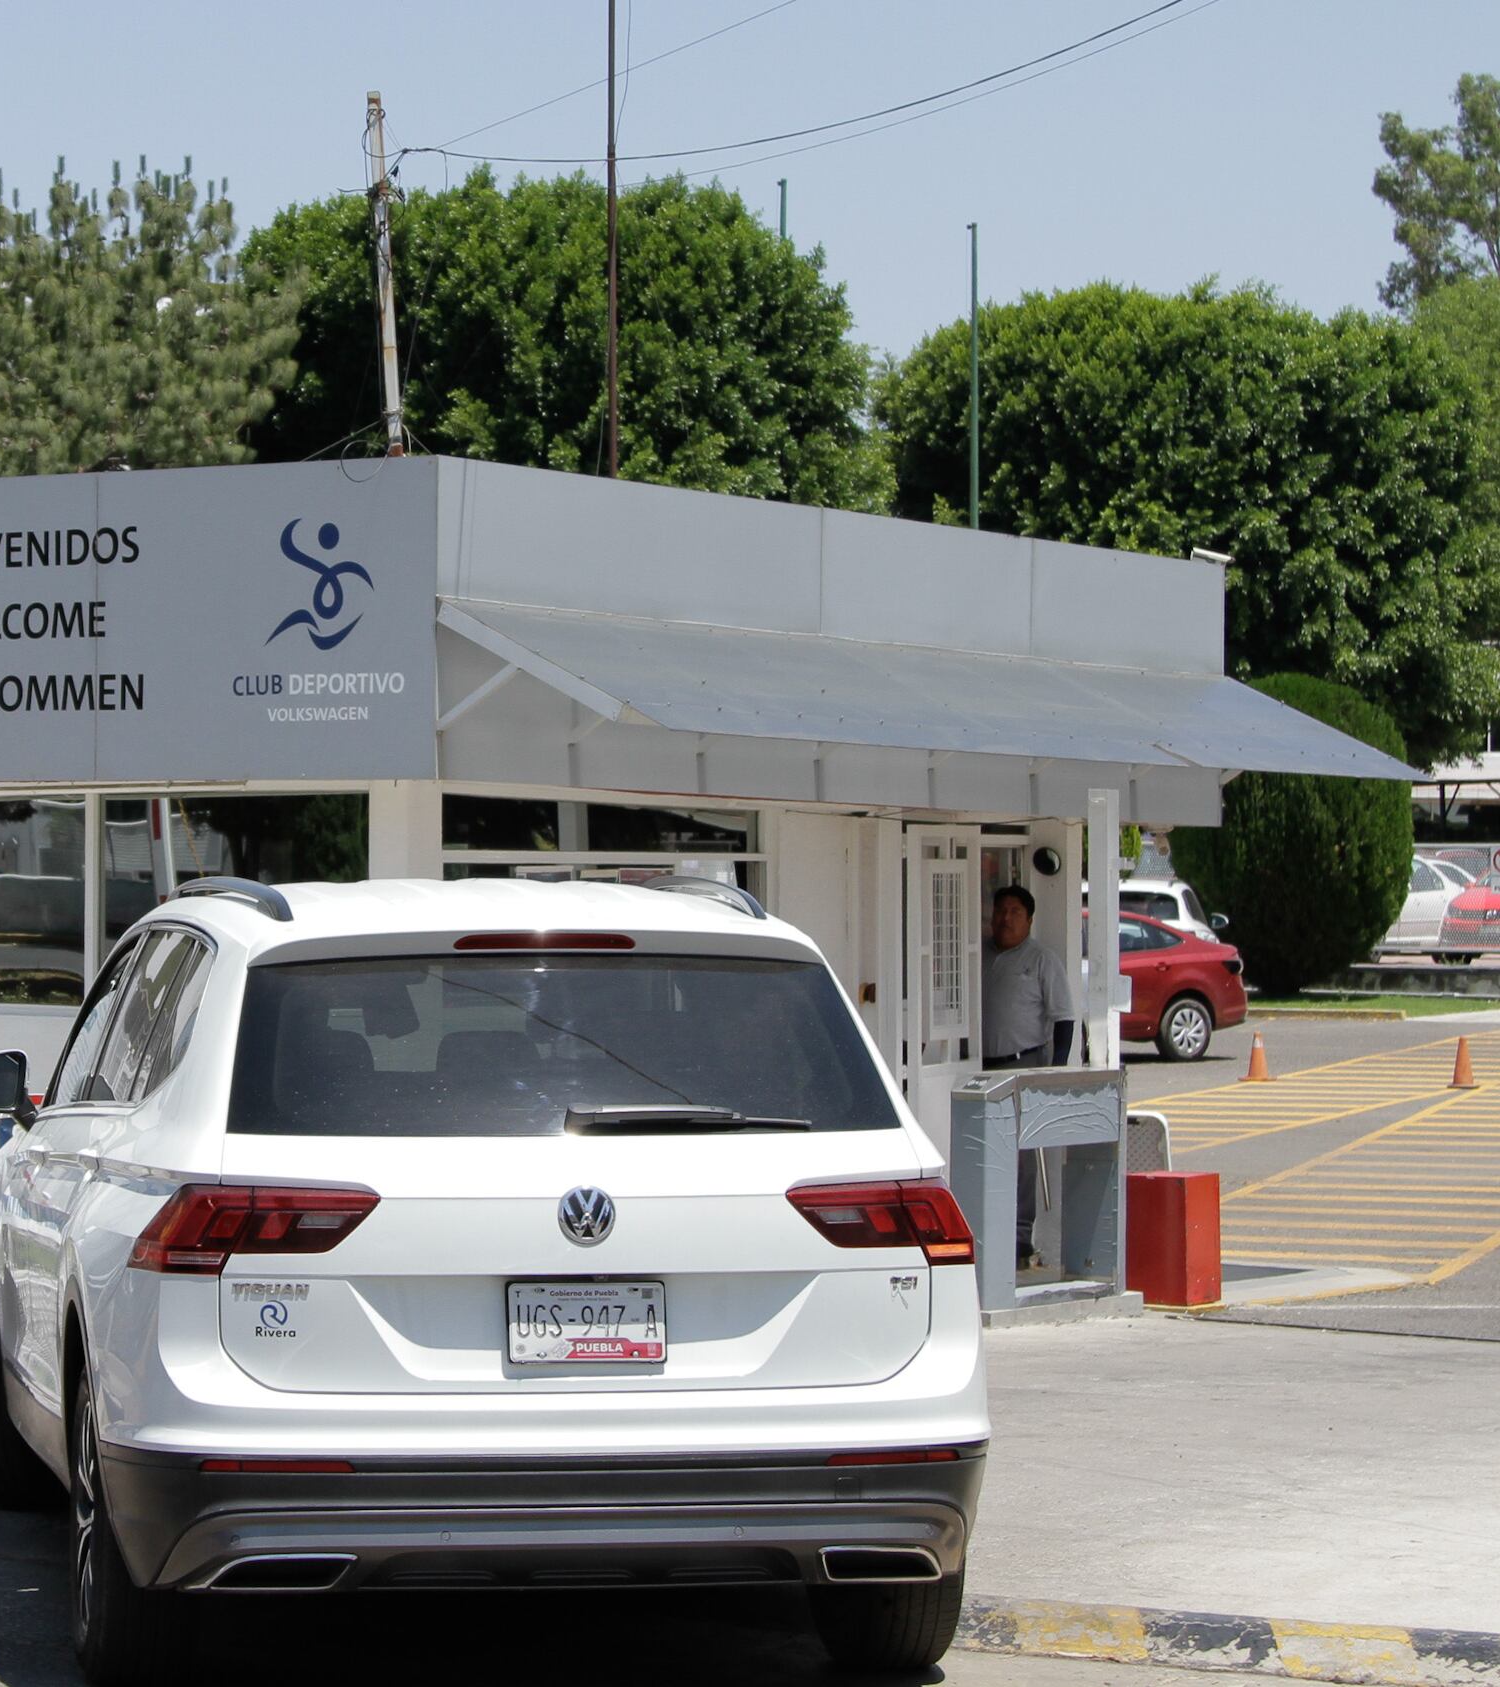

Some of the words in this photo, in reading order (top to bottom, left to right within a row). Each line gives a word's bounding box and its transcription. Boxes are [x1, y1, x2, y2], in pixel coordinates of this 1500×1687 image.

[232, 674, 283, 696] CLUB
[288, 672, 405, 695] DEPORTIVO
[267, 706, 369, 722] VOLKSWAGEN
[559, 1187, 614, 1244] VW
[890, 1276, 918, 1291] TSI
[549, 1289, 583, 1297] Gobierno
[594, 1289, 619, 1297] Puebla
[255, 1326, 296, 1337] Rivera
[576, 1343, 624, 1353] PUEBLA
